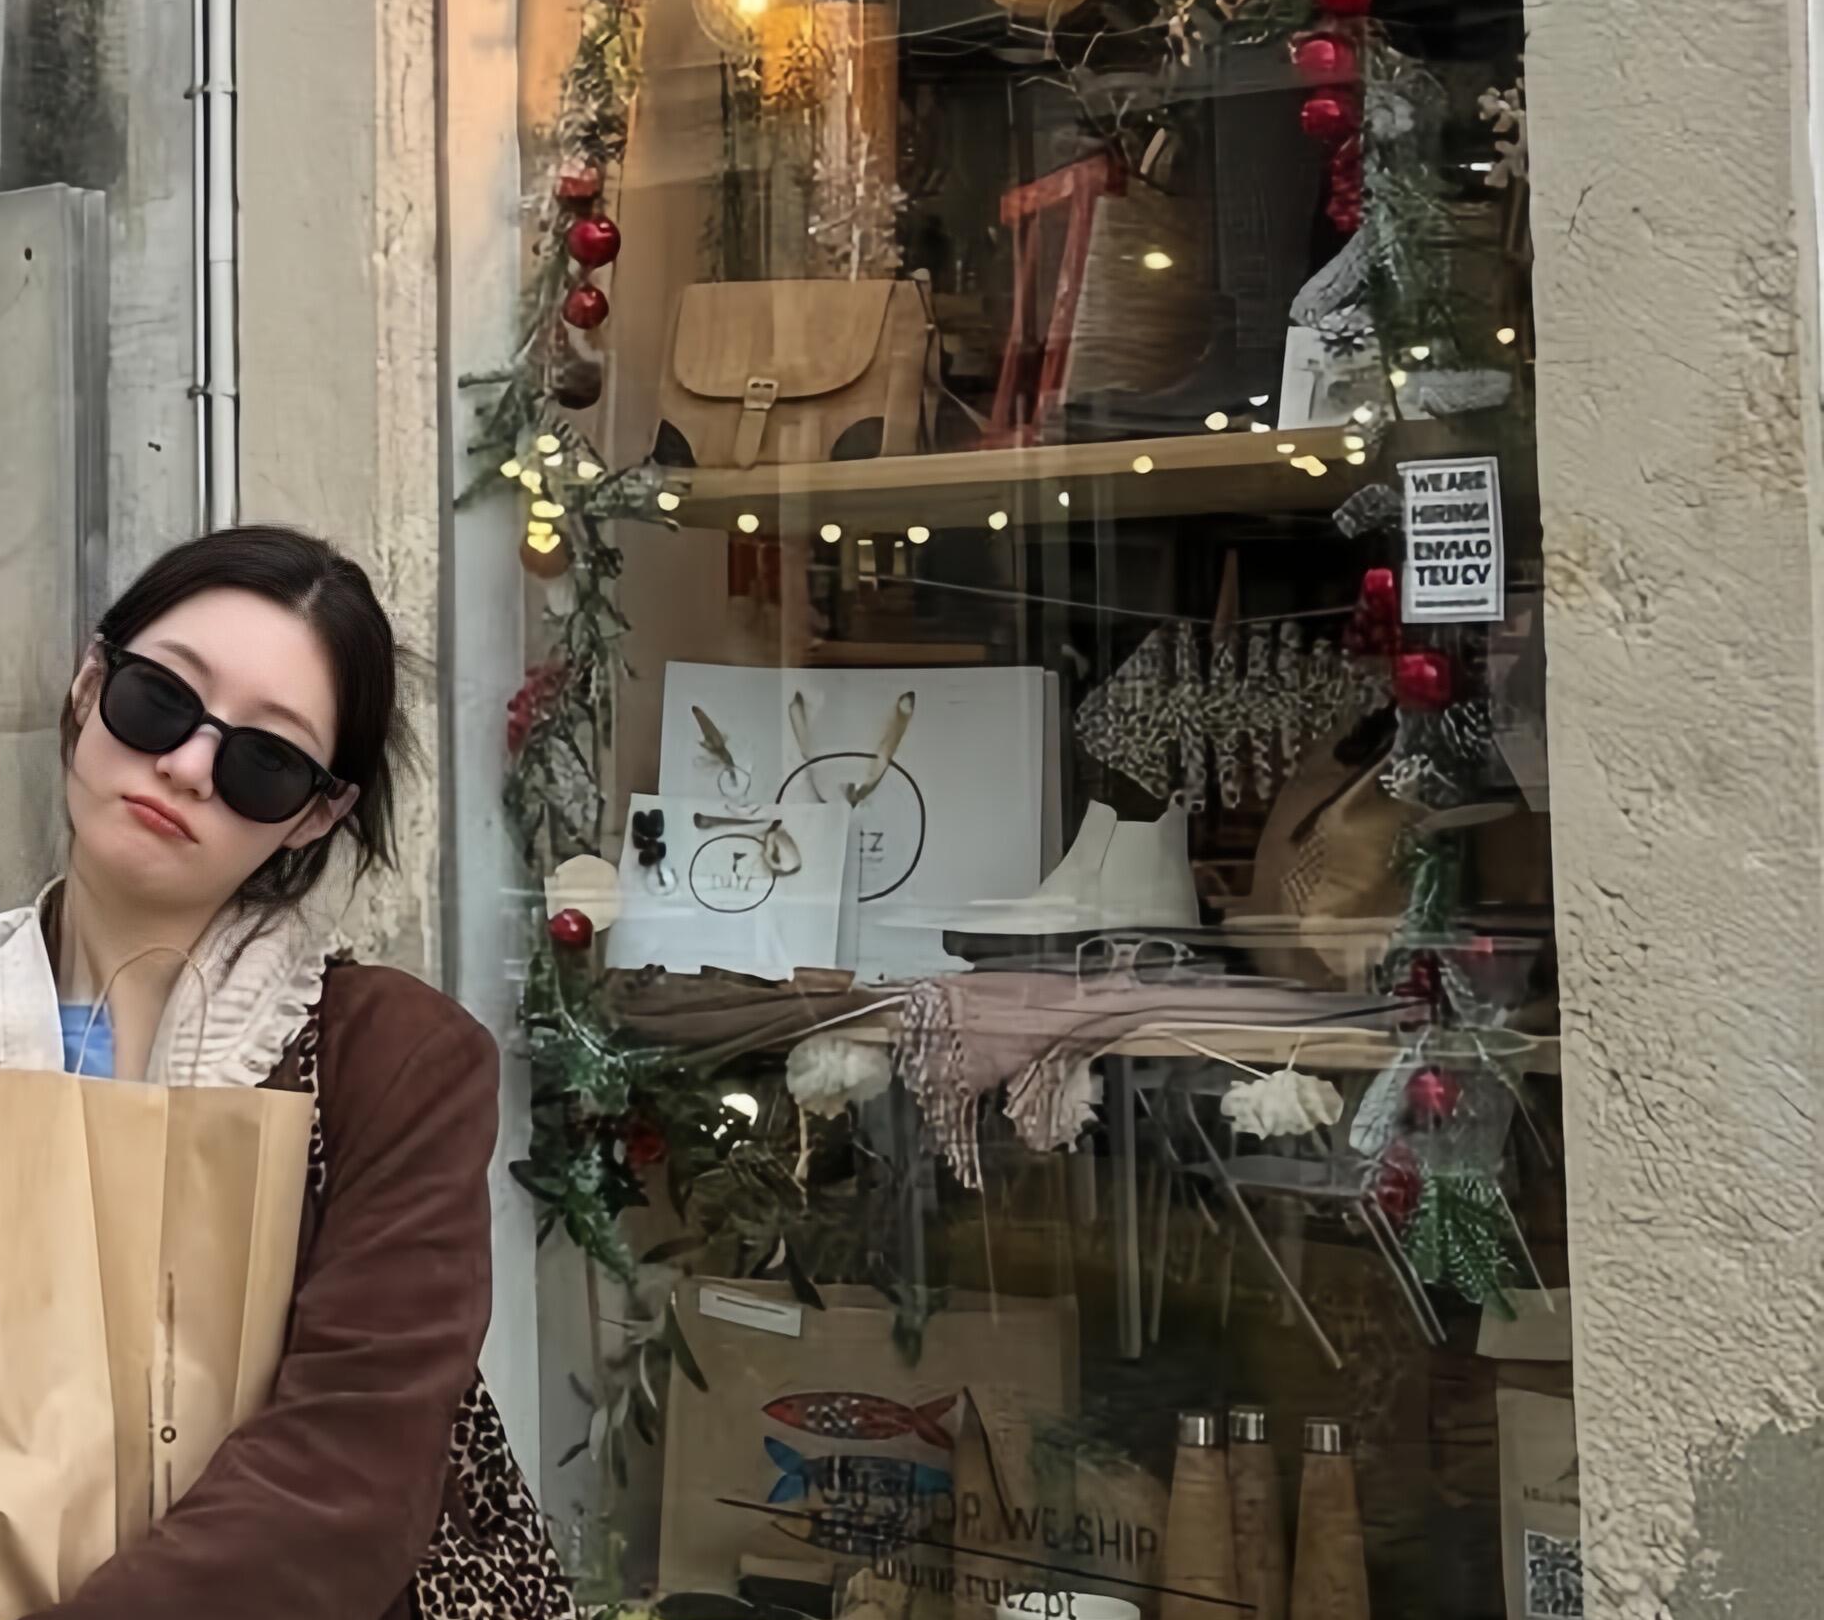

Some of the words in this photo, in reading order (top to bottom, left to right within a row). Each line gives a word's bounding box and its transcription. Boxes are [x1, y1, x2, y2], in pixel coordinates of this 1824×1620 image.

[1415, 565, 1459, 587] TEU
[1460, 563, 1492, 586] CV
[1073, 1512, 1158, 1564] SHIP
